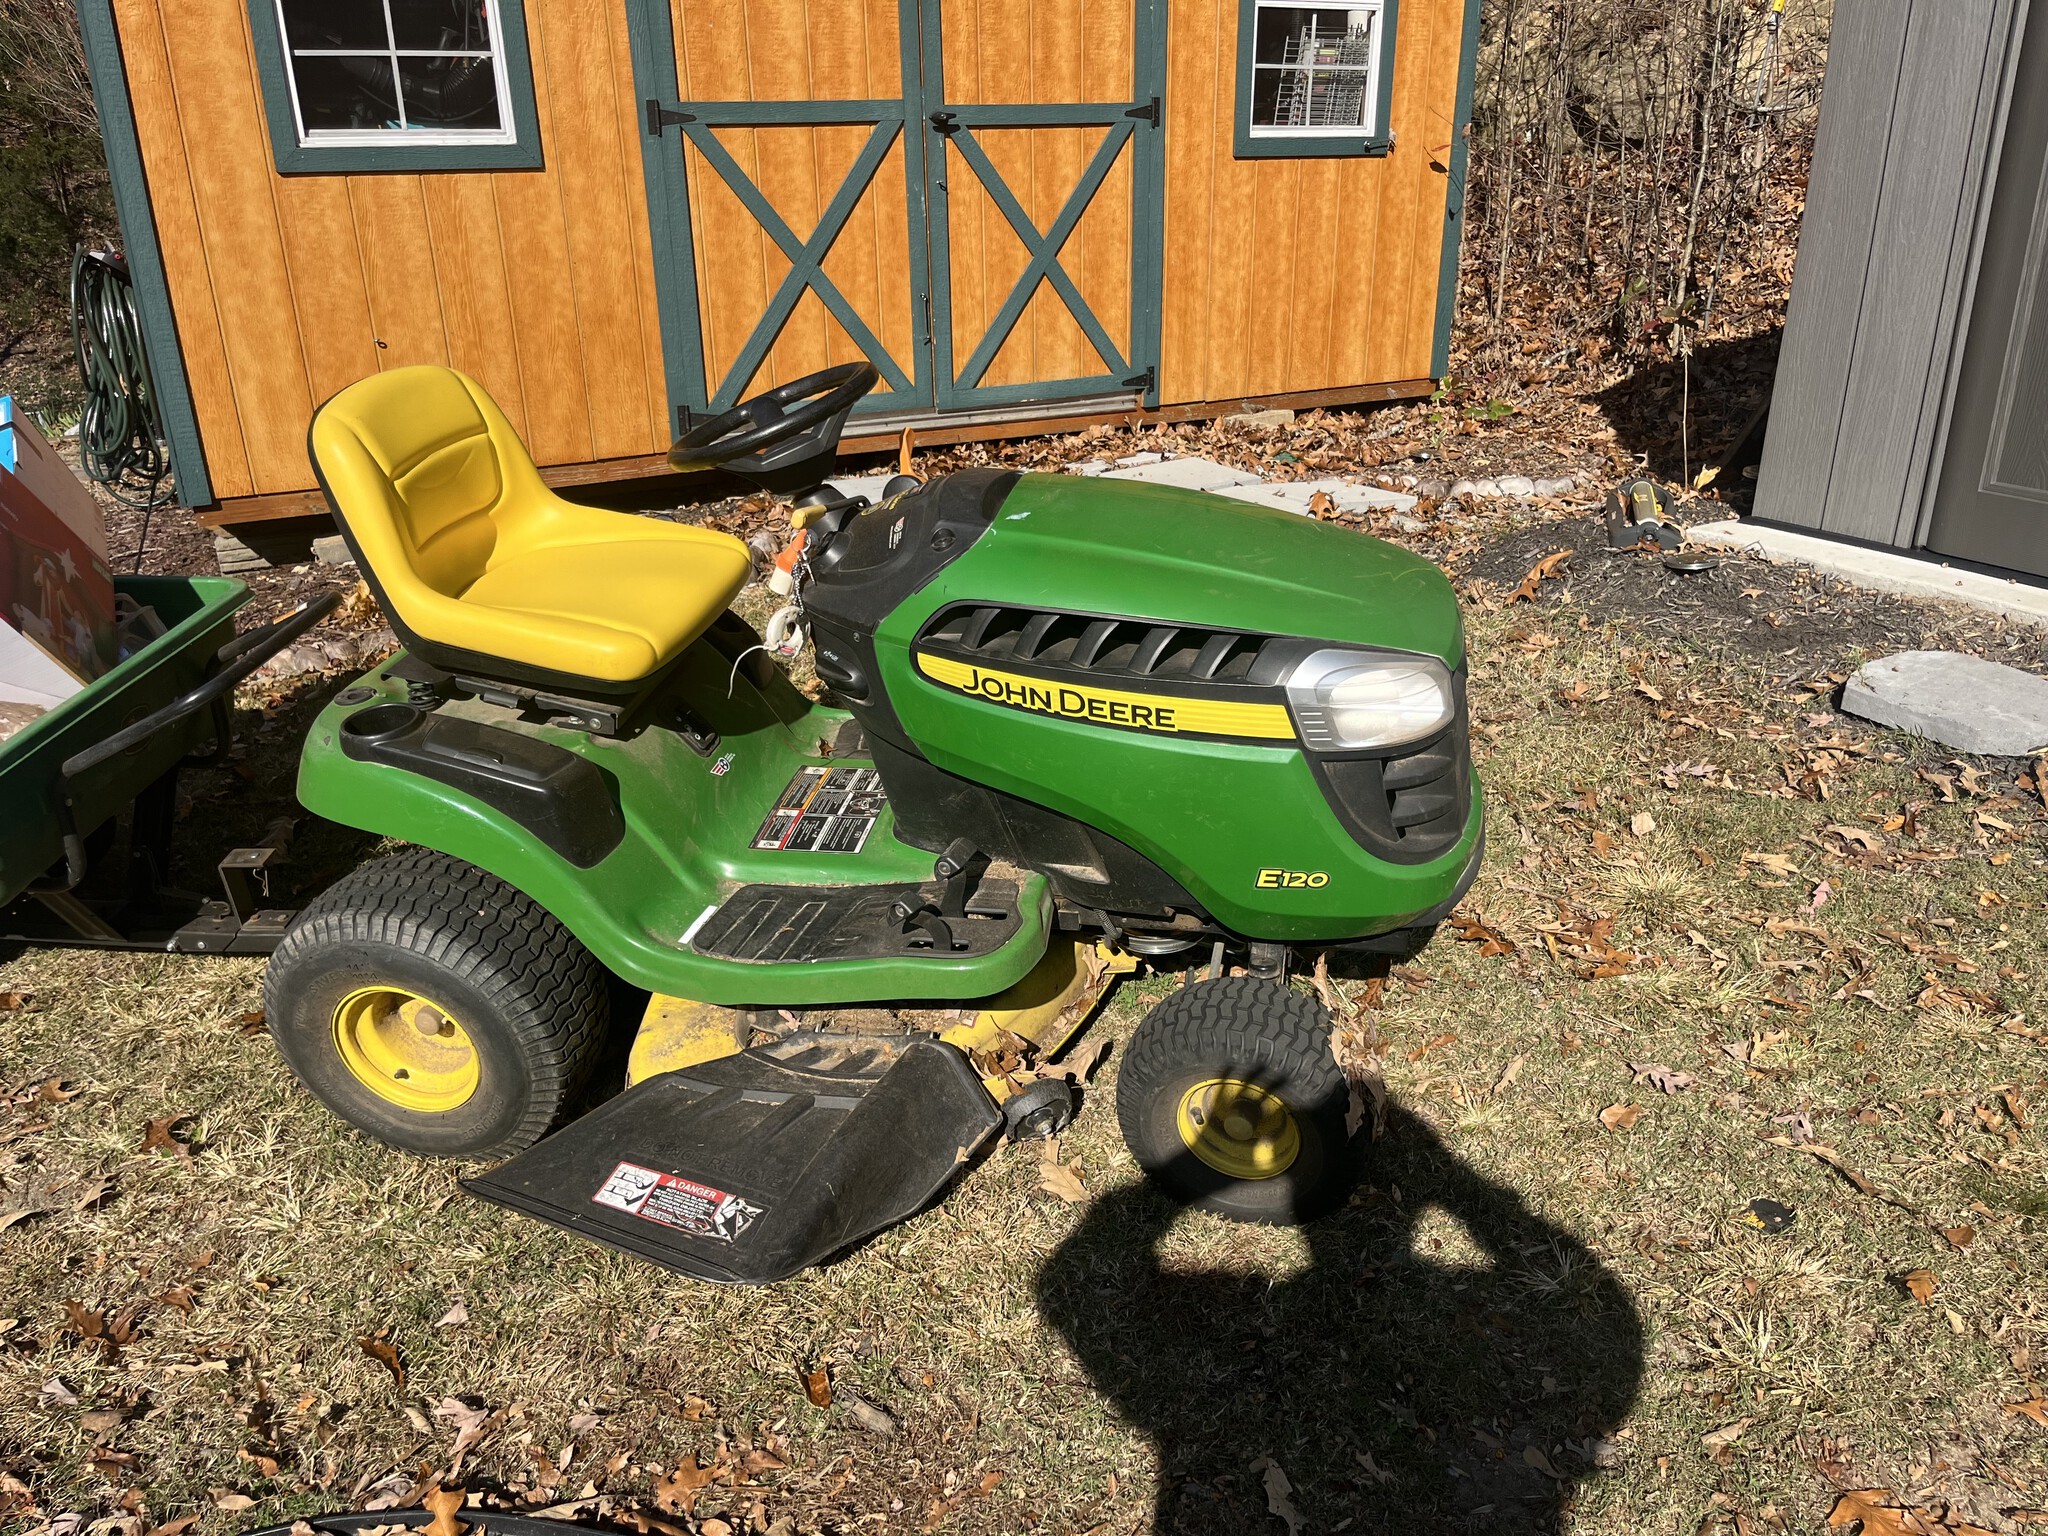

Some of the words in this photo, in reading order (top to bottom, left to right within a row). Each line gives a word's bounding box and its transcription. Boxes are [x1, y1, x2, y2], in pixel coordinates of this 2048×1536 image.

[963, 669, 1051, 710] JOHN
[1058, 688, 1176, 728] DEERE
[1255, 868, 1330, 888] E120
[463, 1095, 504, 1141] CARLISLE
[639, 1137, 665, 1153] DO
[666, 1142, 708, 1166] NOT
[708, 1156, 784, 1189] REMOVE
[666, 1187, 691, 1198] ROTATING
[677, 1181, 717, 1199] DANGER
